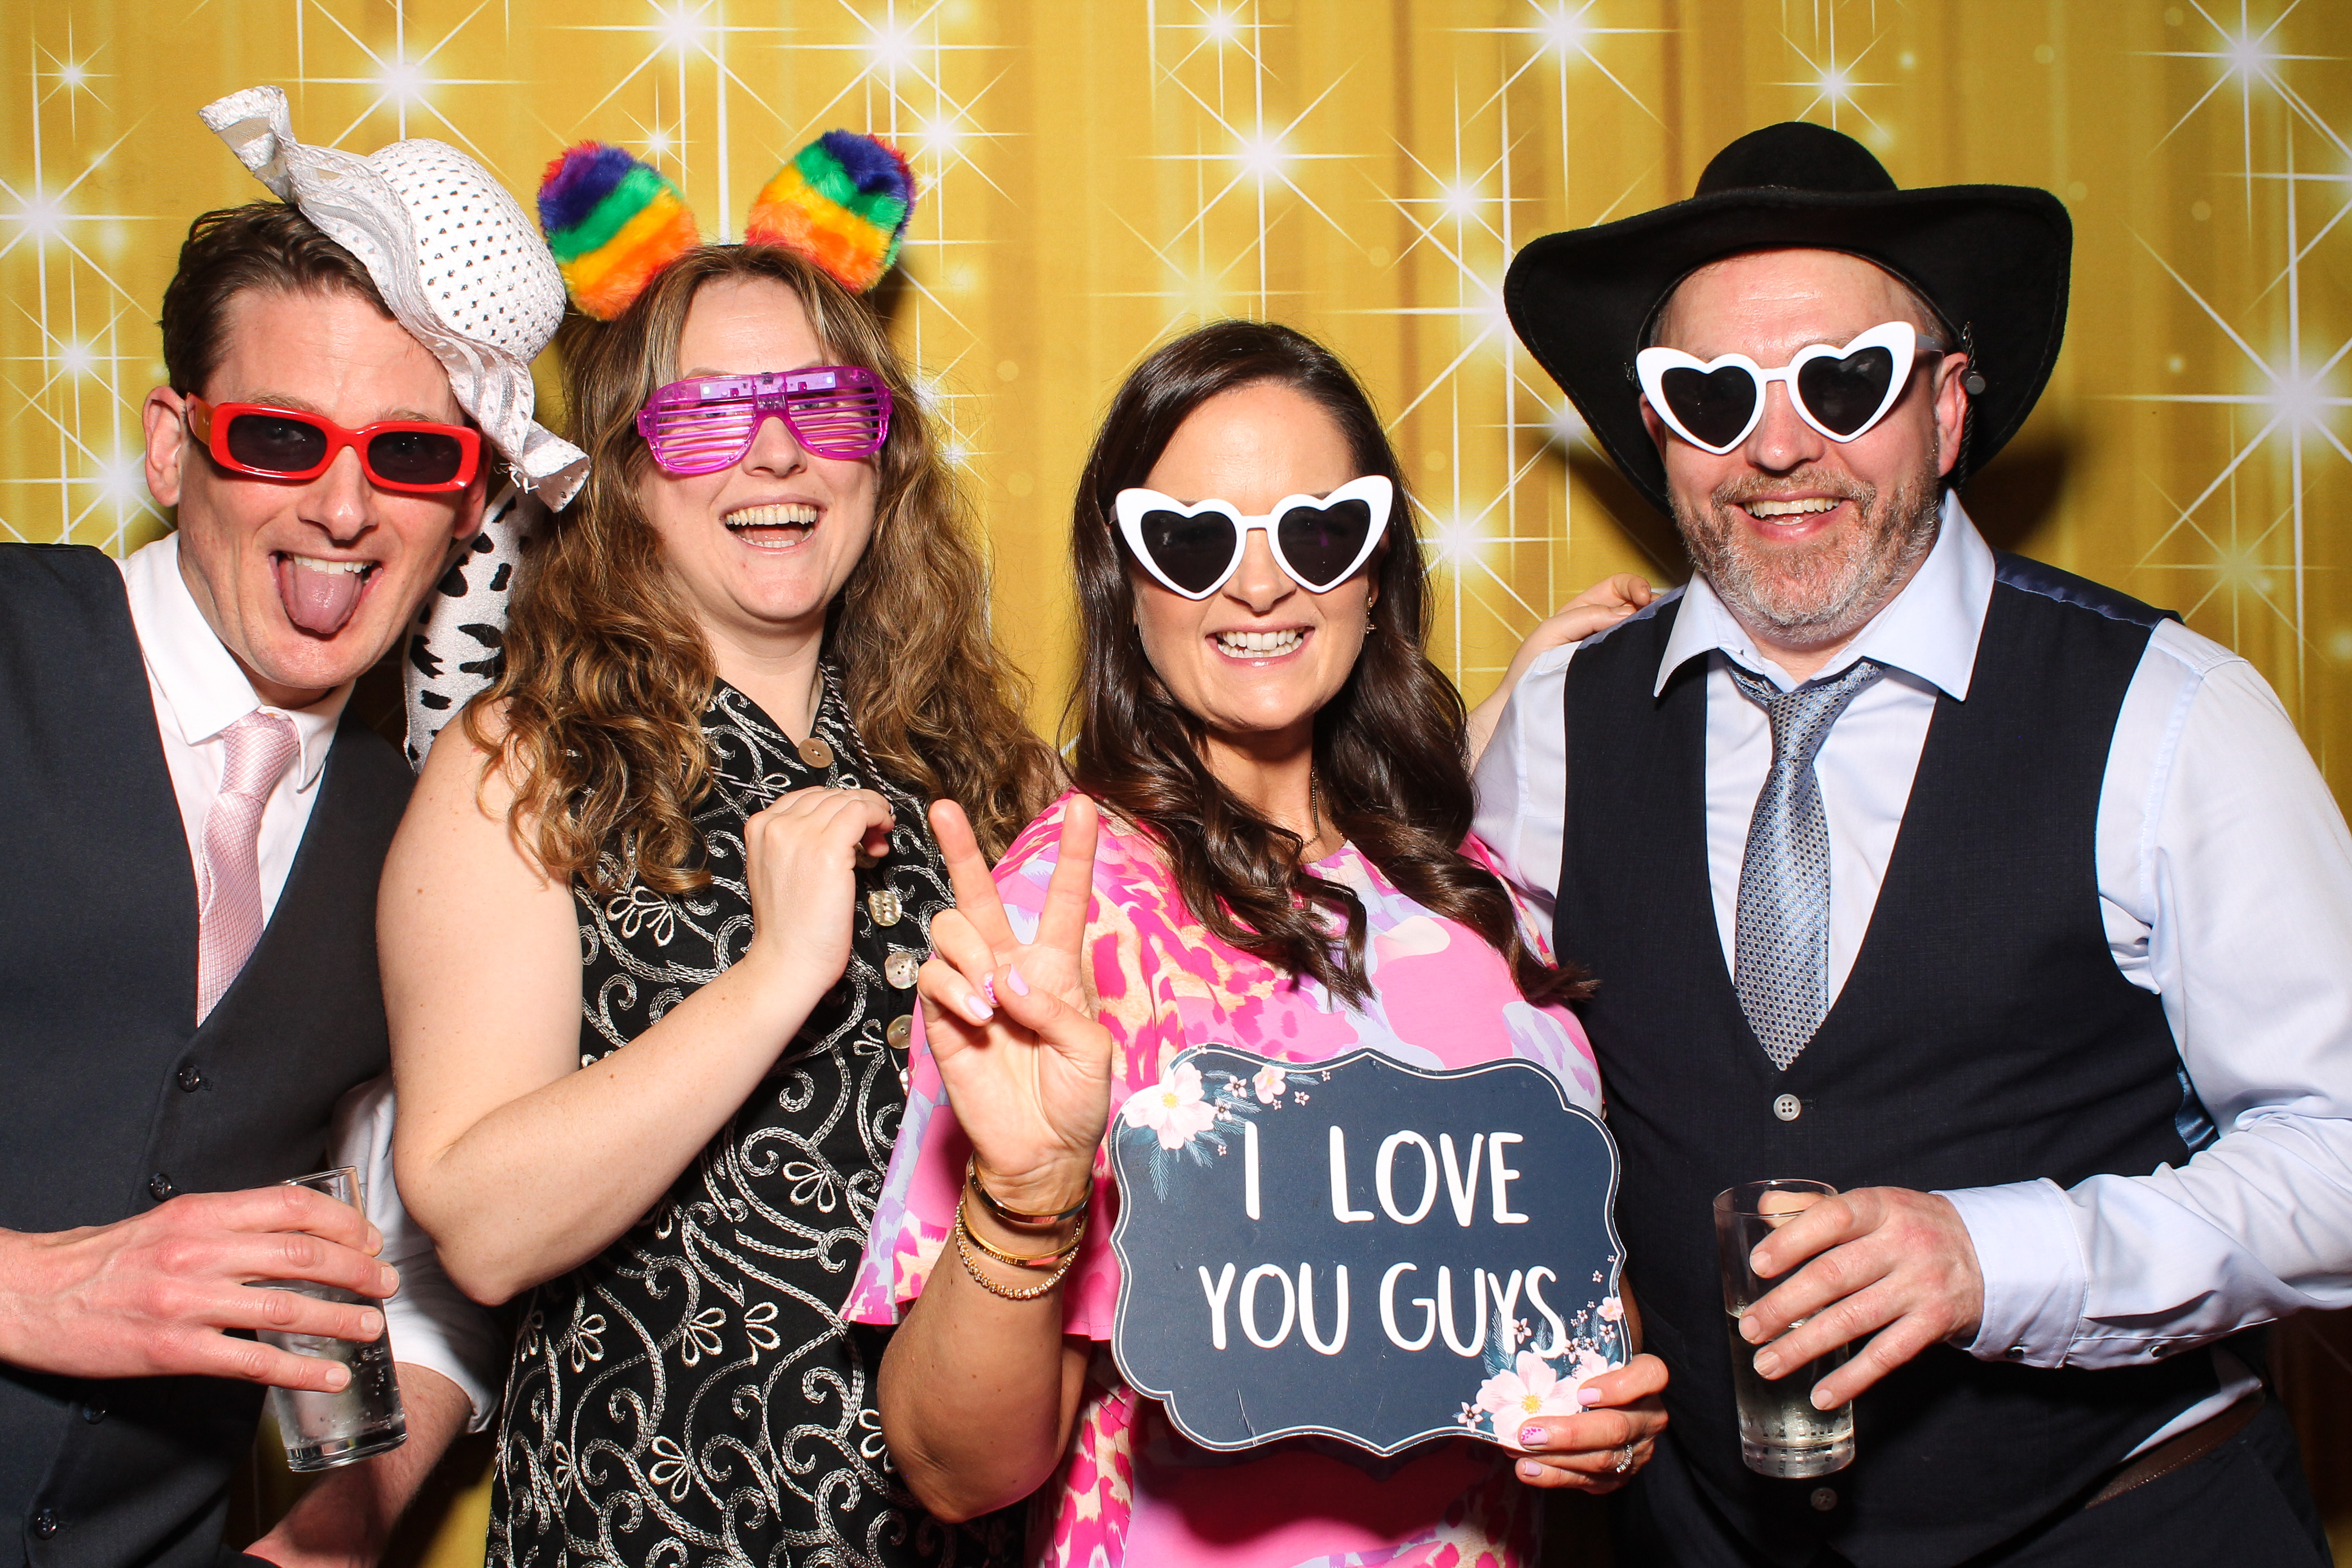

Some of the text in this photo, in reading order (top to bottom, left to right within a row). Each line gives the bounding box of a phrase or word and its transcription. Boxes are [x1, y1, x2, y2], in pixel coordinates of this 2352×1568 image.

[1244, 1121, 1529, 1227] I LOVE
[1198, 1262, 1567, 1359] YOU GUYS
